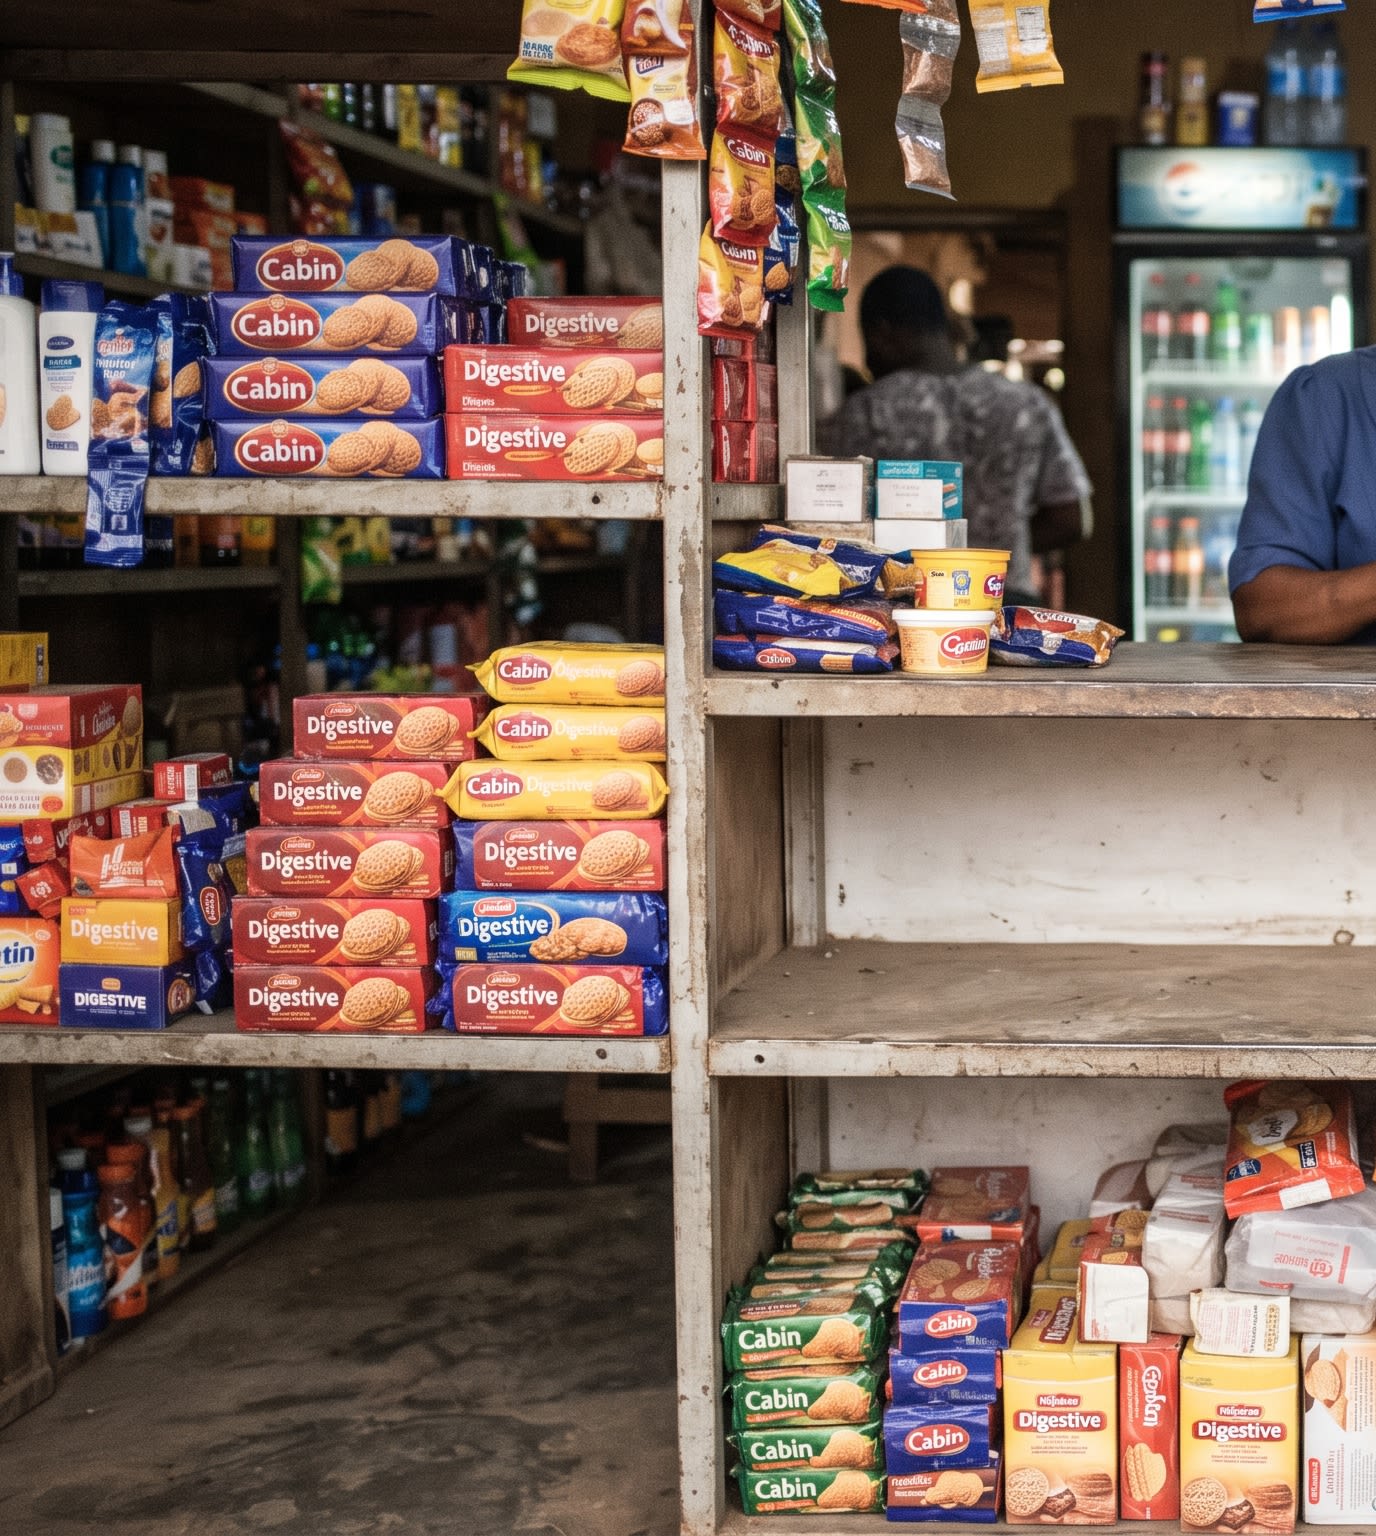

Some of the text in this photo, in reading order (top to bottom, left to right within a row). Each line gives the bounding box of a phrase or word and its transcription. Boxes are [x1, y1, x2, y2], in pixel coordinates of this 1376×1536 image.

[262, 257, 337, 280] Cabin
[238, 313, 314, 336] Cabin
[525, 311, 619, 338] Digestive
[464, 359, 566, 387] Digestive
[230, 376, 306, 400] Cabin
[241, 438, 316, 462] Cabin
[465, 424, 566, 453] Digestive
[500, 657, 617, 681] Cabin Digestive
[307, 715, 394, 741] Digestive
[496, 719, 618, 740] Cabin Digestive
[273, 780, 362, 807] Digestive
[466, 775, 593, 797] Cabin Digestive
[260, 850, 352, 878] Digestive
[484, 840, 577, 868] Digestive
[71, 918, 159, 945] Digestive
[248, 917, 339, 945] Digestive
[459, 914, 549, 943] Digestive
[0, 941, 35, 965] tin
[74, 991, 147, 1010] DIGESTIVE
[248, 986, 339, 1013] Digestive
[466, 984, 558, 1011] Digestive
[928, 1315, 972, 1333] Cabin
[738, 1327, 802, 1350] Cabin
[917, 1363, 962, 1381] Cabin
[744, 1389, 809, 1411] Cabin
[1018, 1411, 1101, 1433] Digestive
[1197, 1421, 1282, 1443] Digestive
[750, 1439, 814, 1461] Cabin
[908, 1427, 965, 1452] Cabin
[754, 1478, 817, 1500] Cabin
